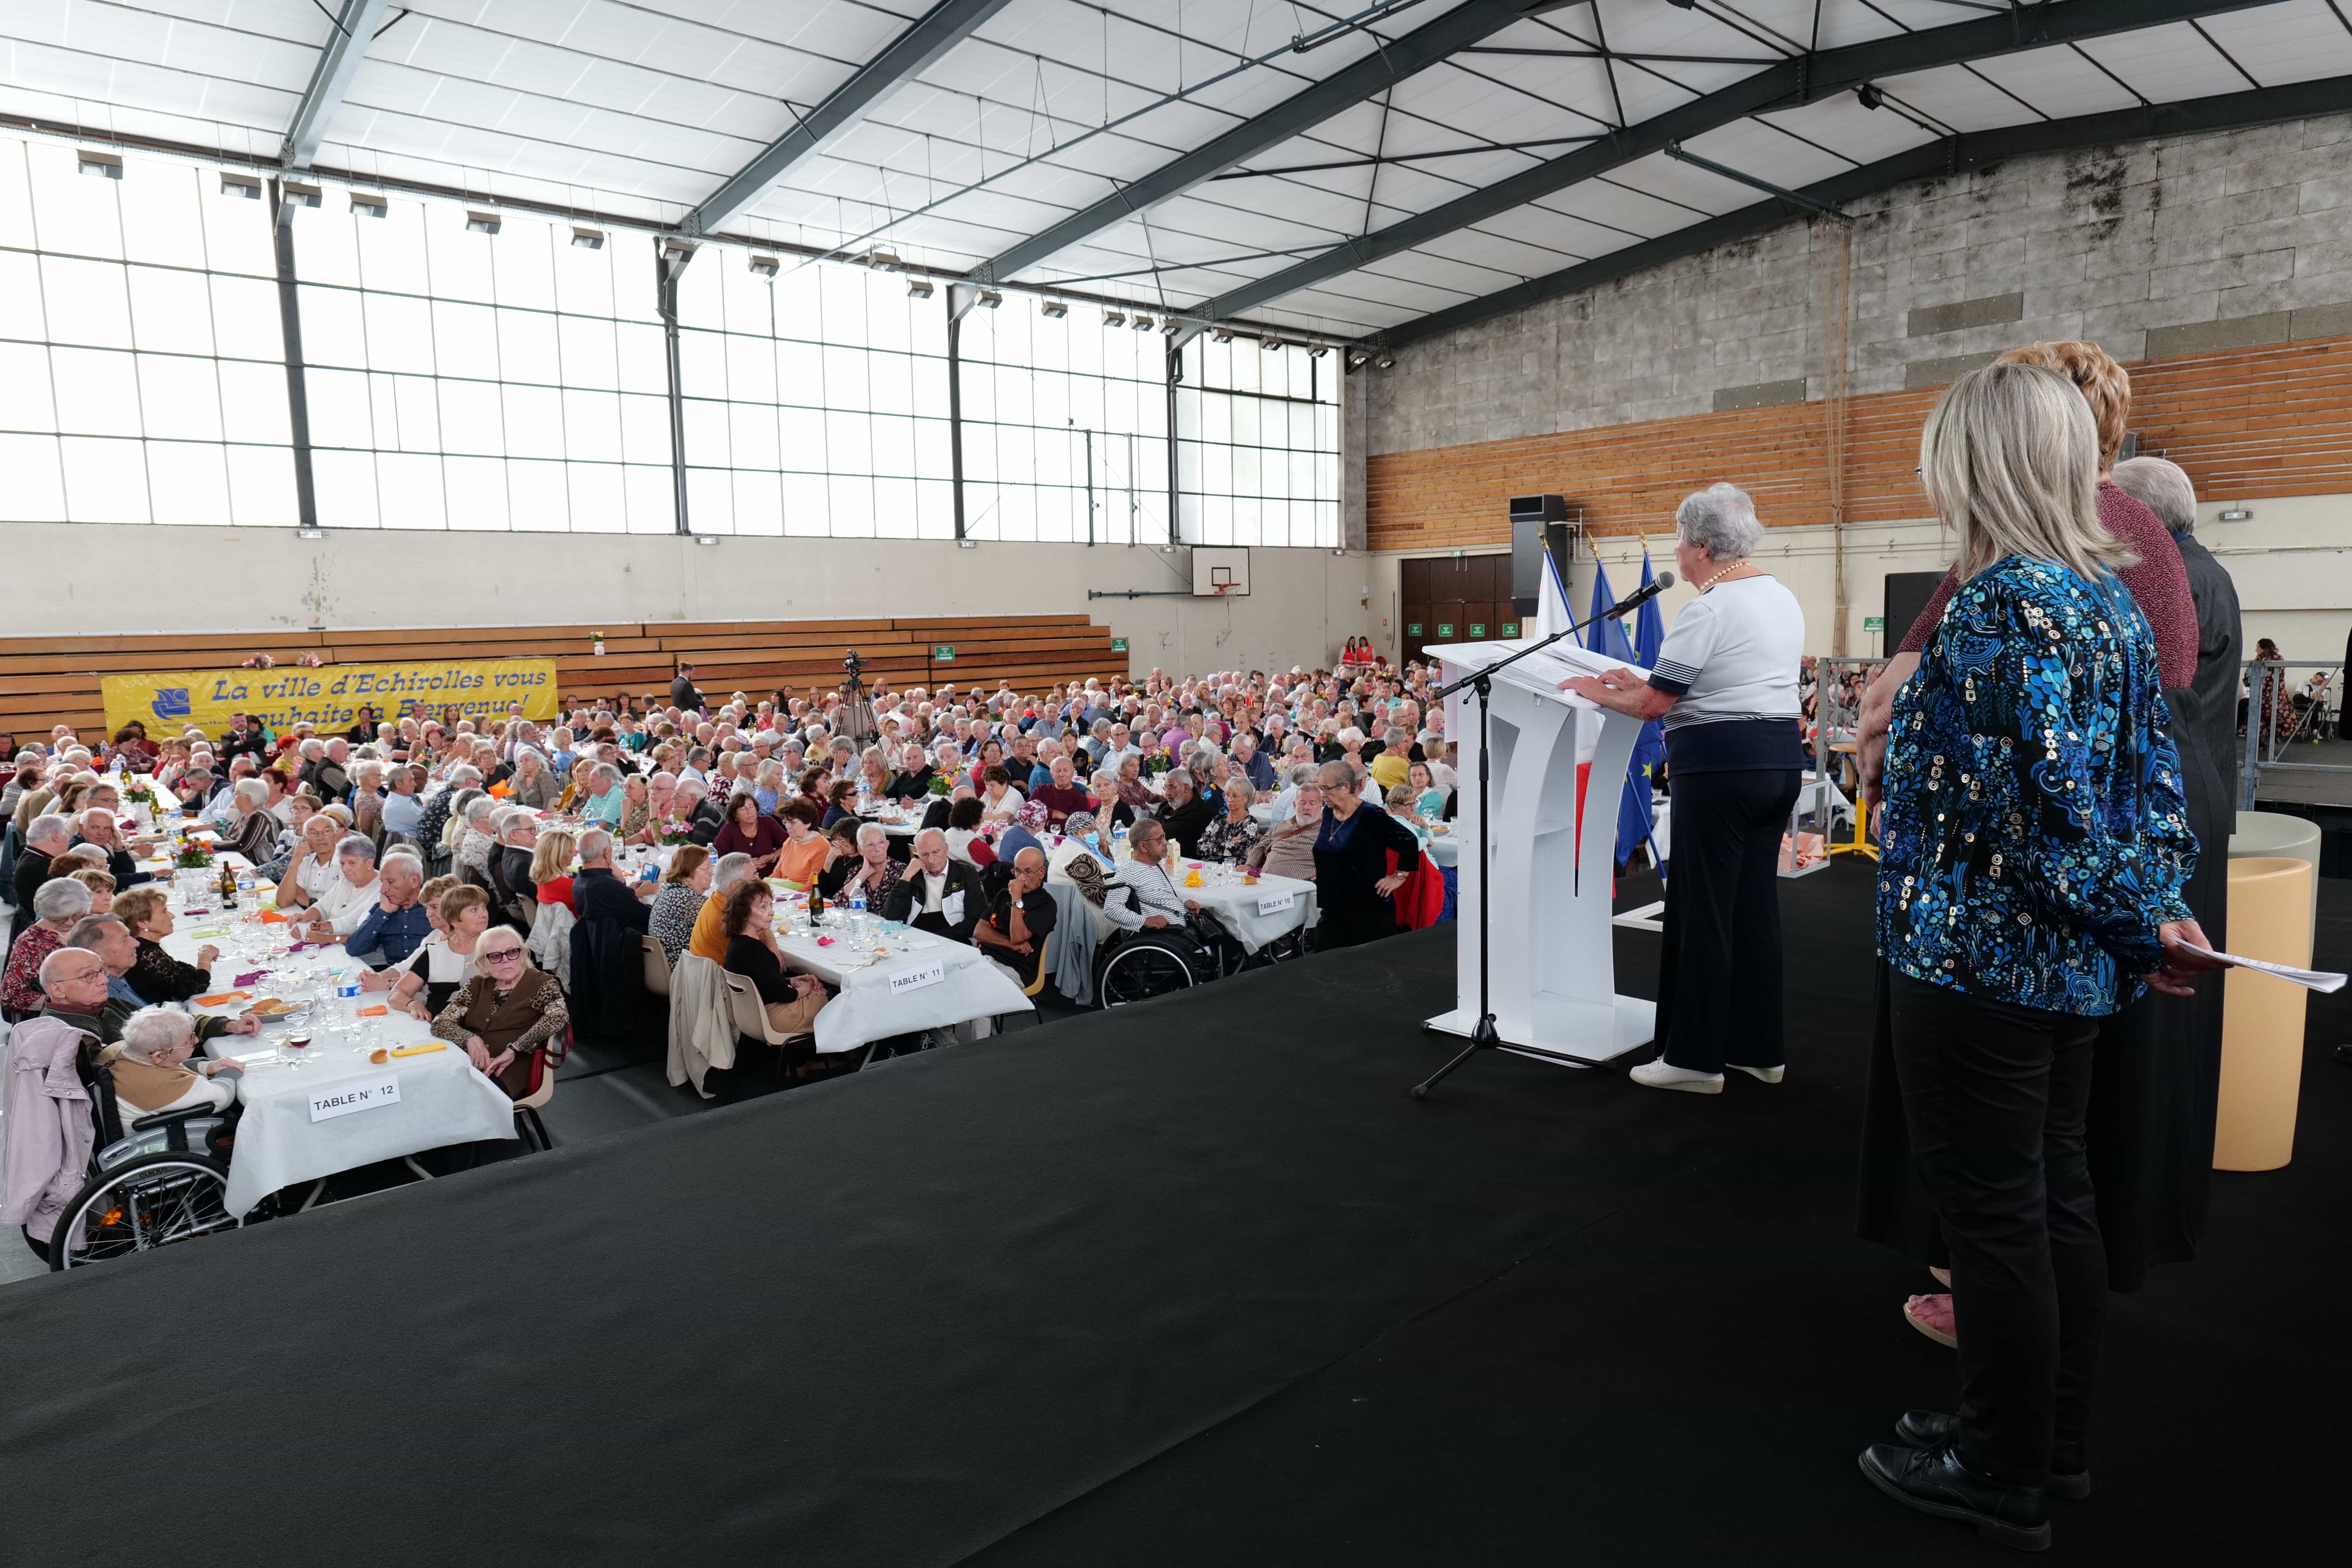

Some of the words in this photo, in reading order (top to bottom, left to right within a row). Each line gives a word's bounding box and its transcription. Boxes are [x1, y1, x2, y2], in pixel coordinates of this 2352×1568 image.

[212, 680, 248, 701] La
[262, 677, 321, 698] ville
[330, 670, 484, 694] d'Echirolles
[494, 671, 546, 686] vous
[257, 703, 353, 726] ouhaite
[1260, 901, 1276, 910] TABLE
[893, 975, 918, 988] TABLE
[920, 972, 927, 980] N°
[314, 1094, 356, 1110] TABLE
[359, 1090, 372, 1100] N°
[380, 1085, 394, 1095] 12
